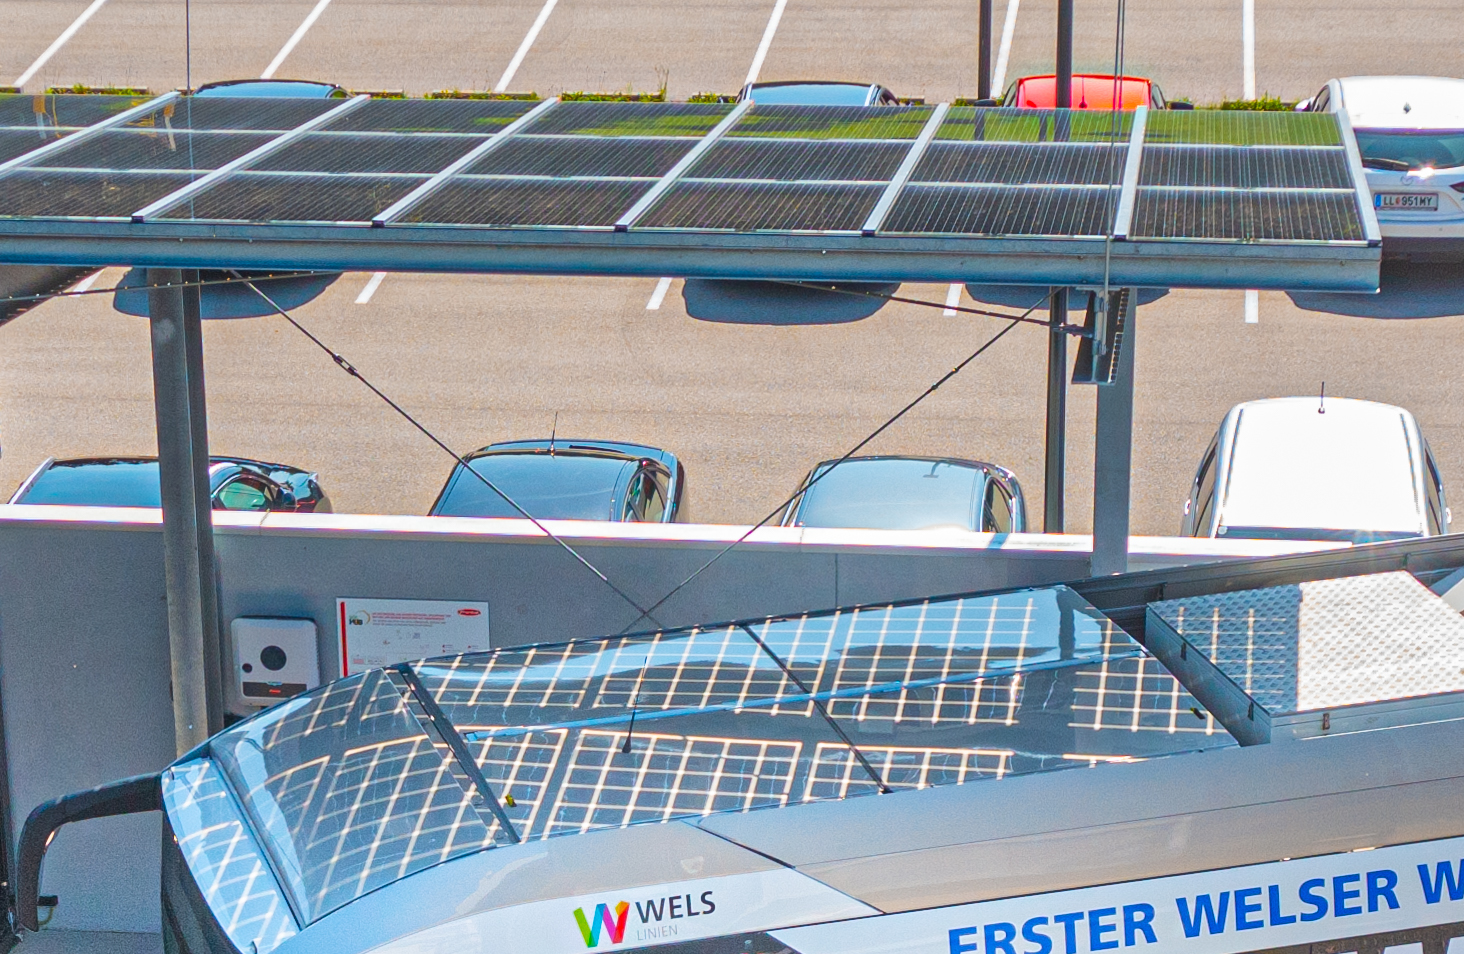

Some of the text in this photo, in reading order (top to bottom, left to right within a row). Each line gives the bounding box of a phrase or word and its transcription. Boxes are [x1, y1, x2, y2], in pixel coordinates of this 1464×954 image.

[635, 890, 717, 924] WELS
[1176, 869, 1401, 938] WELSER
[636, 924, 679, 941] LINIEN
